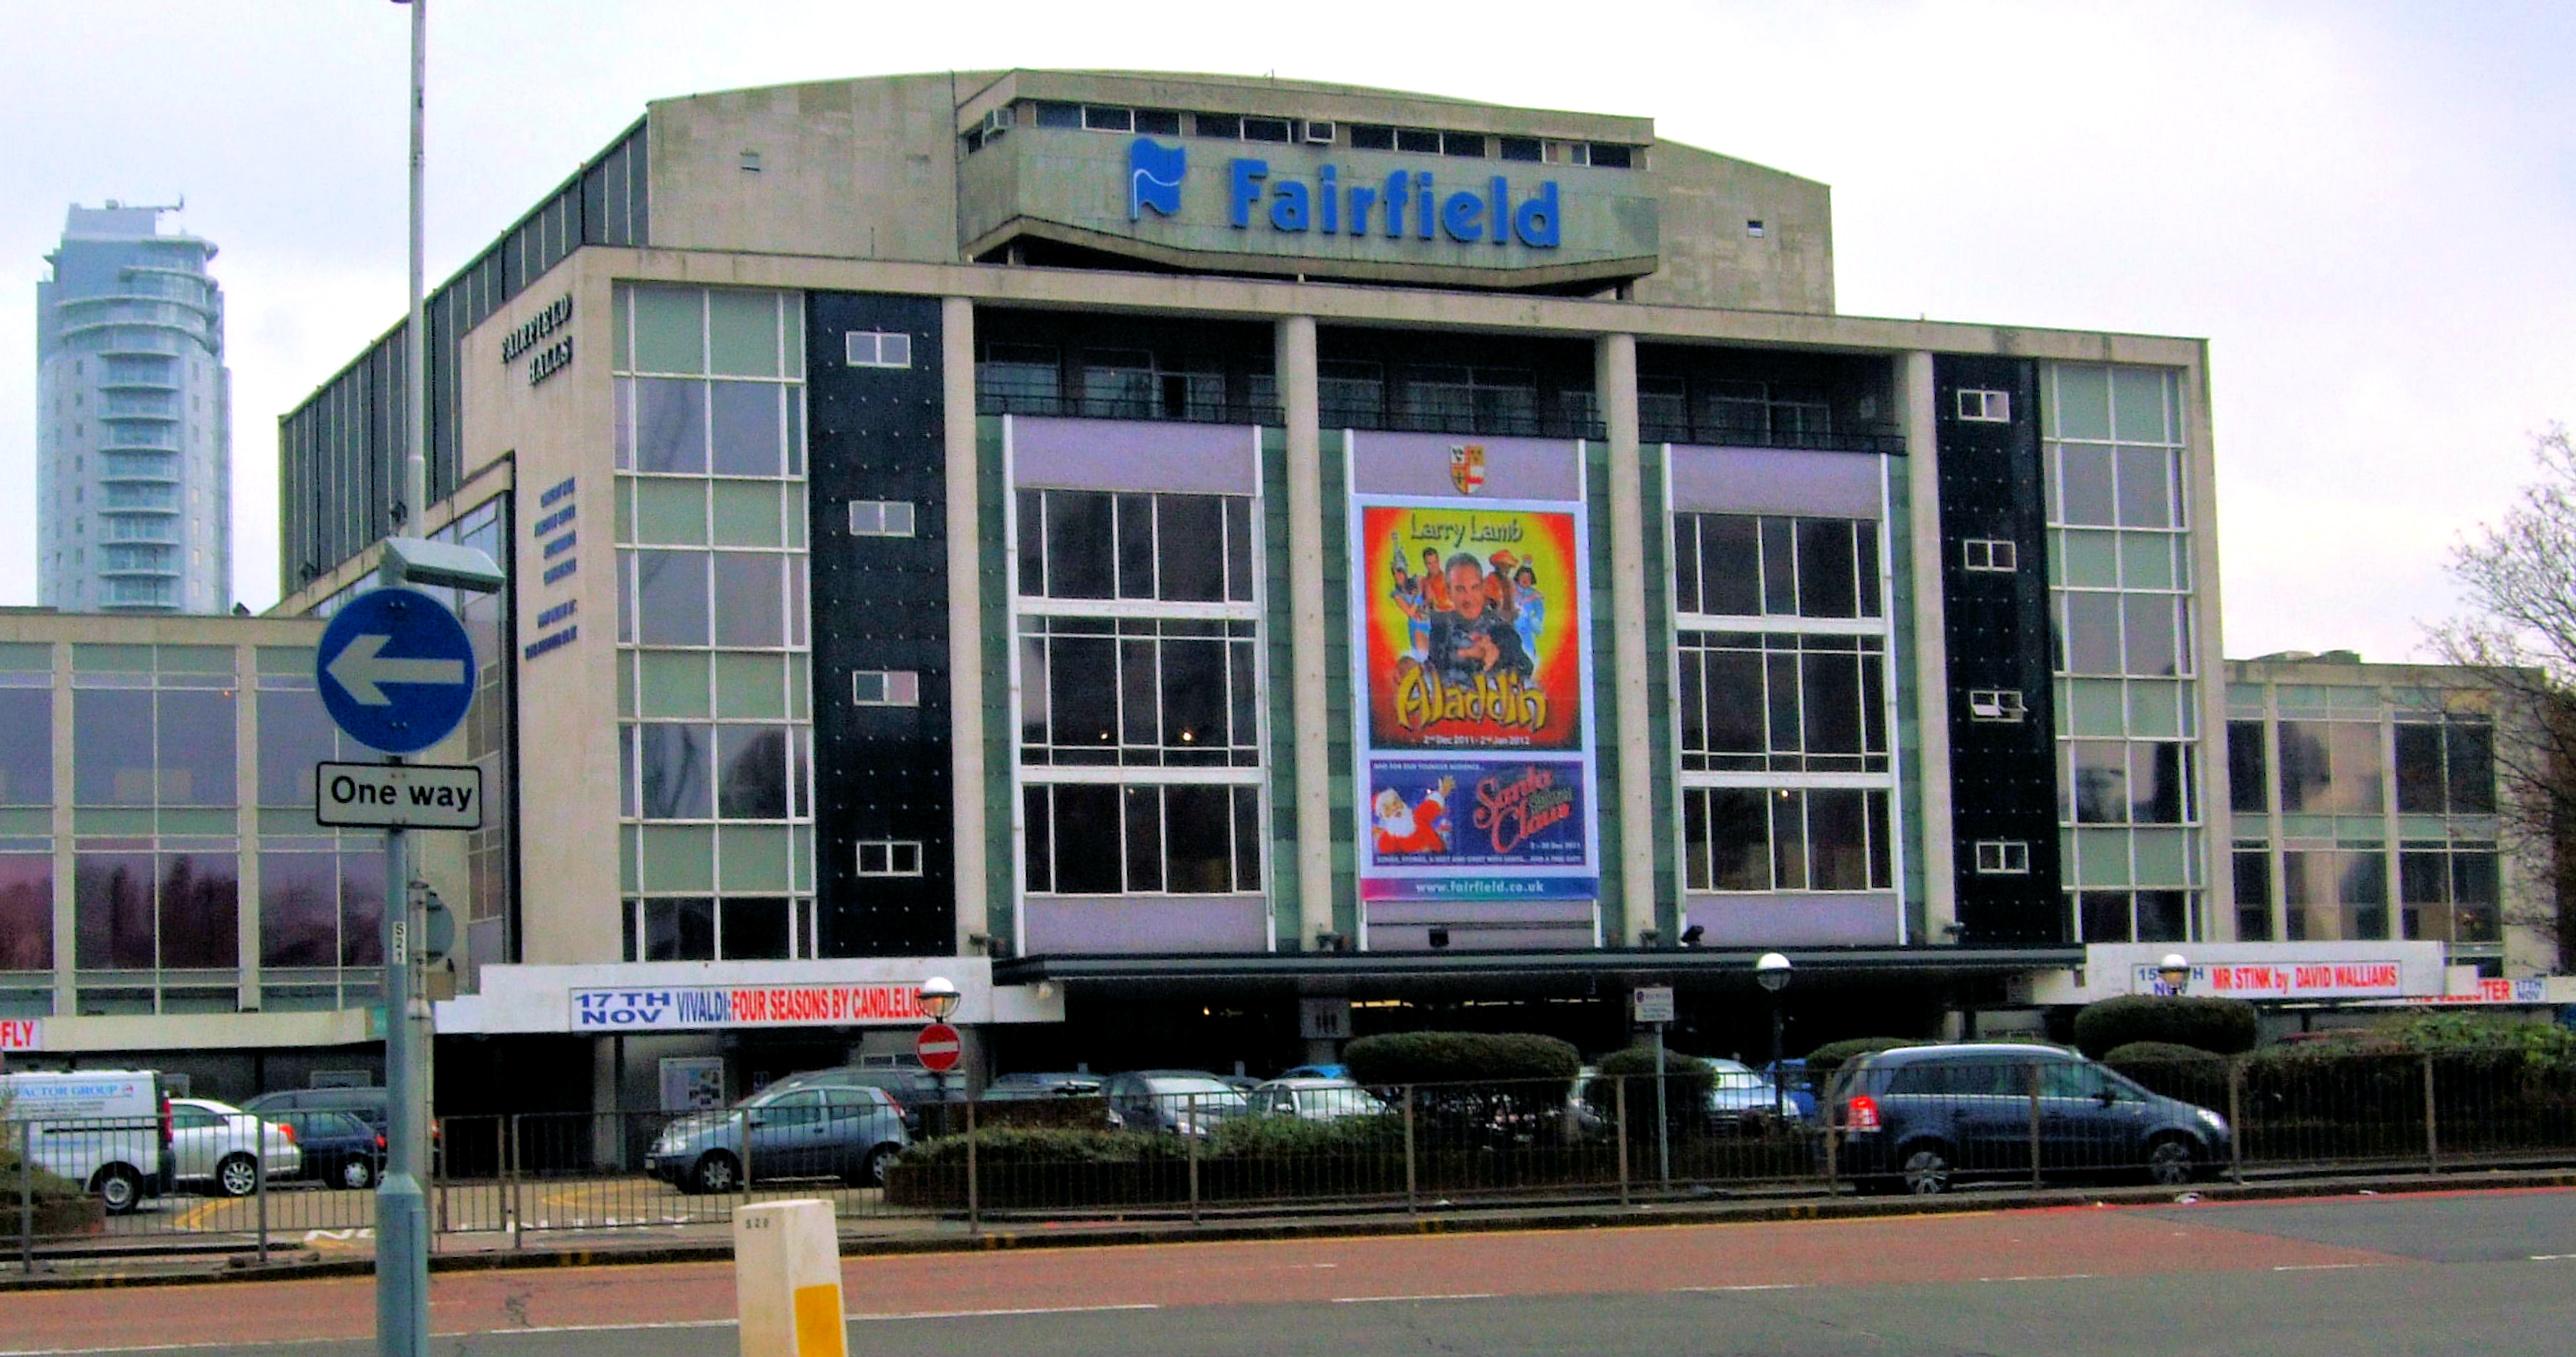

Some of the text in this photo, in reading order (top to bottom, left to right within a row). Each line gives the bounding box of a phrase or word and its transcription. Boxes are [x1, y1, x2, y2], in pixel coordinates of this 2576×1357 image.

[1229, 158, 1560, 248] Fairfield
[529, 335, 573, 387] HALLS
[1410, 512, 1524, 548] Larry Lamb
[1397, 664, 1547, 732] Aladdin
[331, 776, 473, 812] One way
[1473, 763, 1553, 829] Santa
[1416, 880, 1544, 893] www.fairfield.co.uk
[2138, 967, 2204, 981] 15H
[2213, 965, 2397, 994] MR STINK by DAVID WALLIAMS
[581, 1008, 663, 1025] NOV
[732, 989, 767, 1021] FOUR
[770, 988, 829, 1021] SEASONS
[832, 987, 850, 1020] BY
[852, 986, 925, 1019] CANDLELIG
[2, 1021, 34, 1047] FLY
